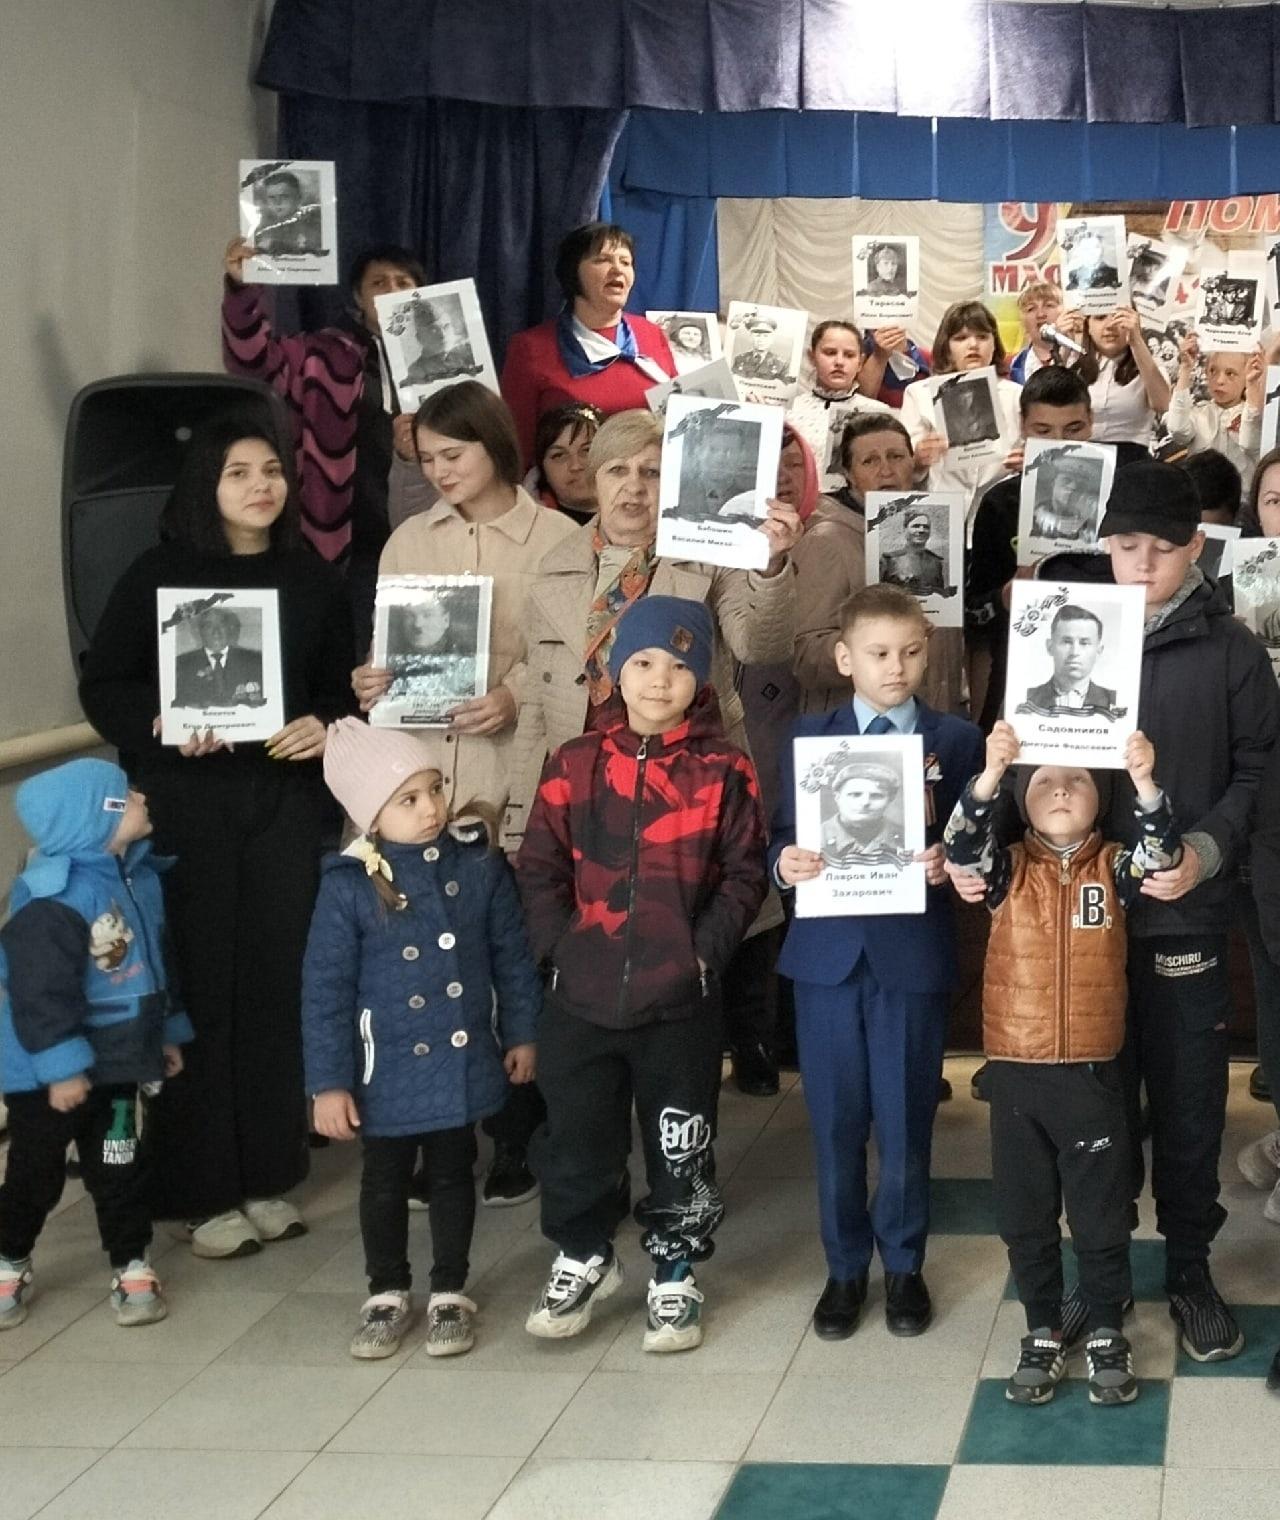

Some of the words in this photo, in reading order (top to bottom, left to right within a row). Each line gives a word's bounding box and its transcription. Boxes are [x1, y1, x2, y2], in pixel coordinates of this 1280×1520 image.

[1038, 723, 1110, 735] Садовников
[1020, 740, 1060, 749] Дмитрий
[825, 872, 866, 882] Лавров
[870, 872, 898, 880] Иван
[831, 888, 893, 898] Захарович
[1081, 883, 1107, 929] B
